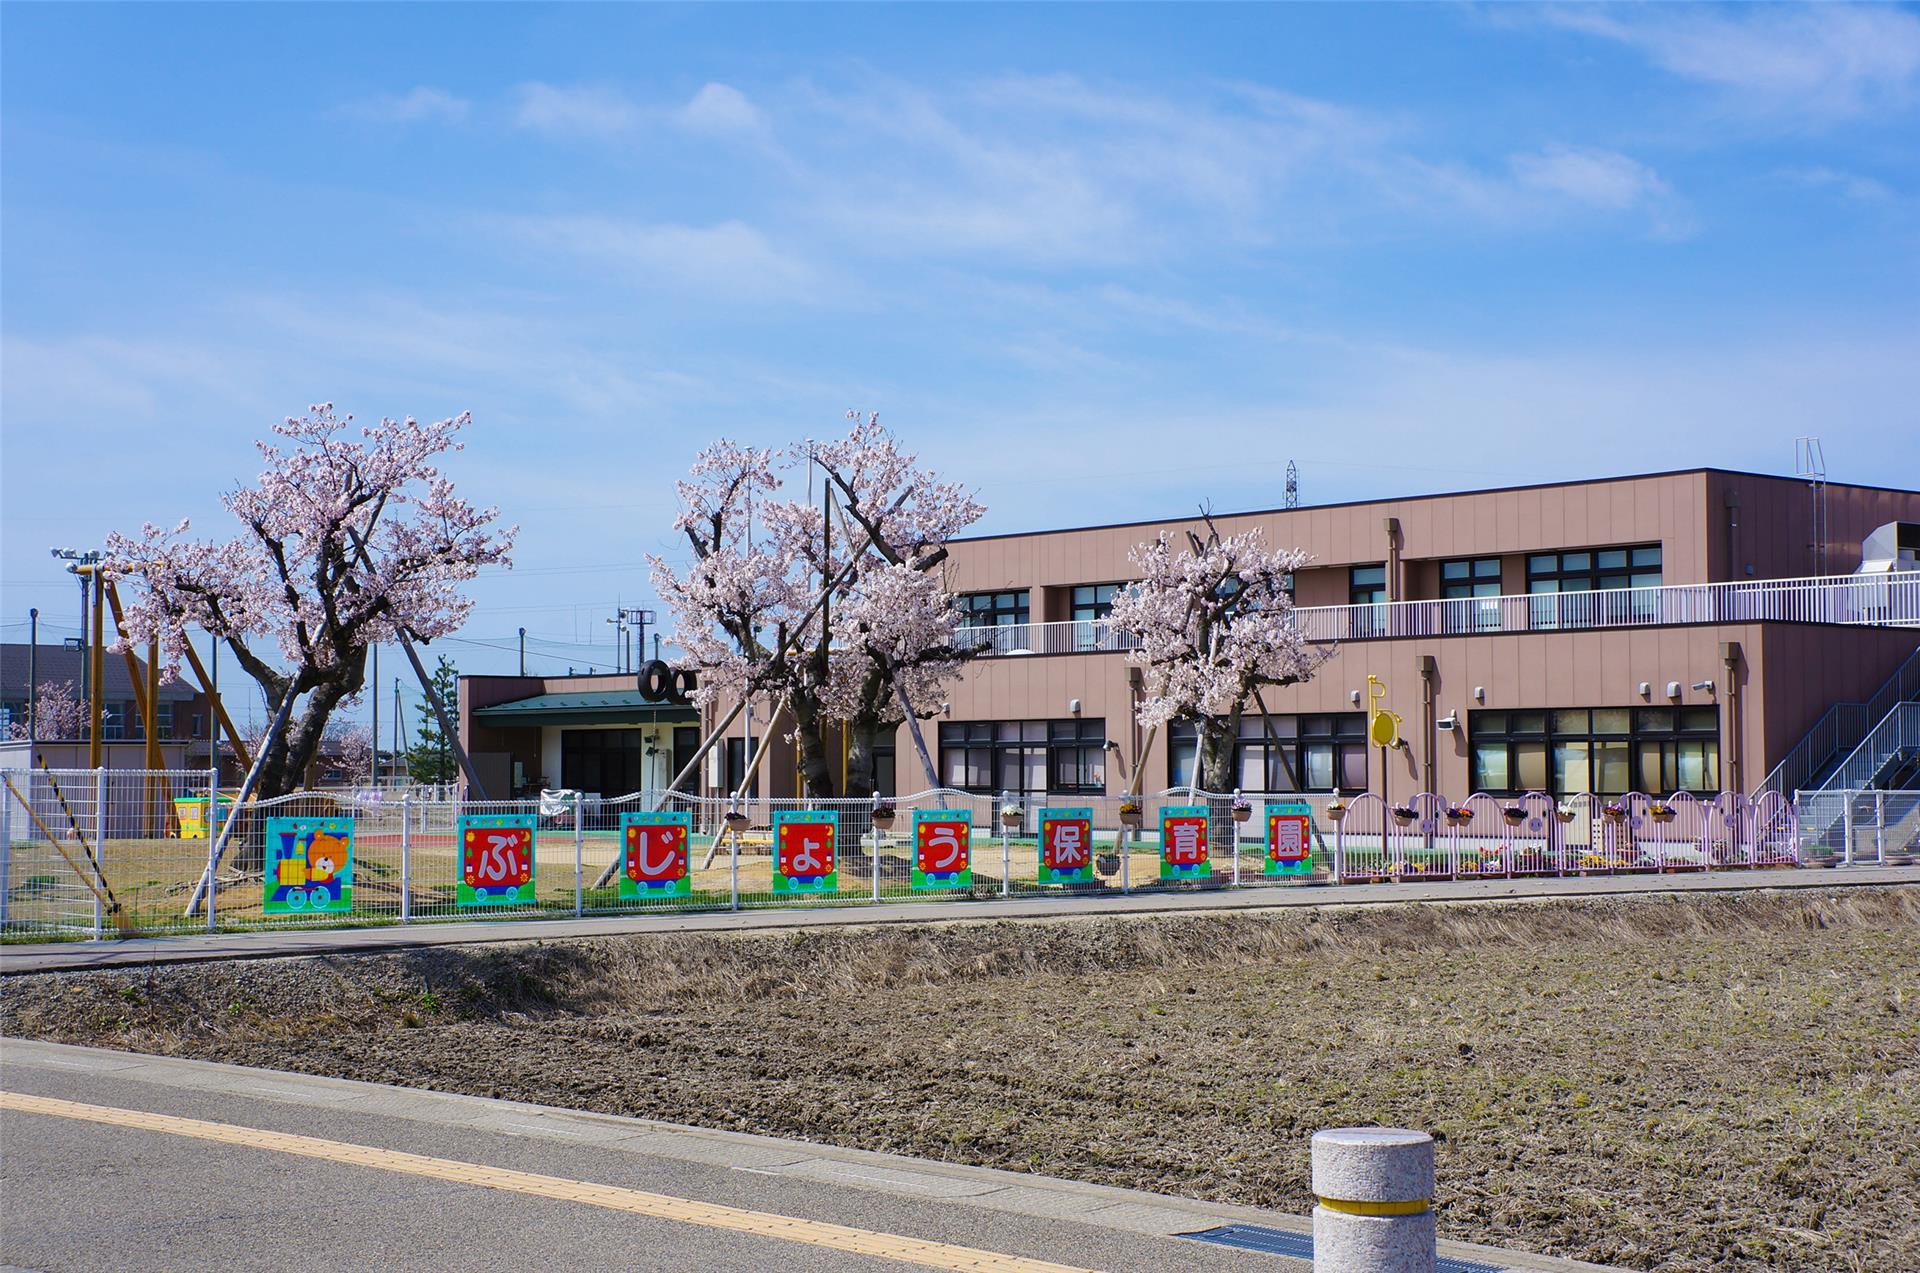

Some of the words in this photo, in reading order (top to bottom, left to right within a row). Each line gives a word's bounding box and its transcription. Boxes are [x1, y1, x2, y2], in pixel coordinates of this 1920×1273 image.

[478, 834, 518, 881] ぶ
[639, 831, 676, 876] じ
[928, 827, 959, 868] う
[1053, 825, 1081, 864] 保
[1173, 822, 1199, 860] 育
[1277, 819, 1302, 857] 園
